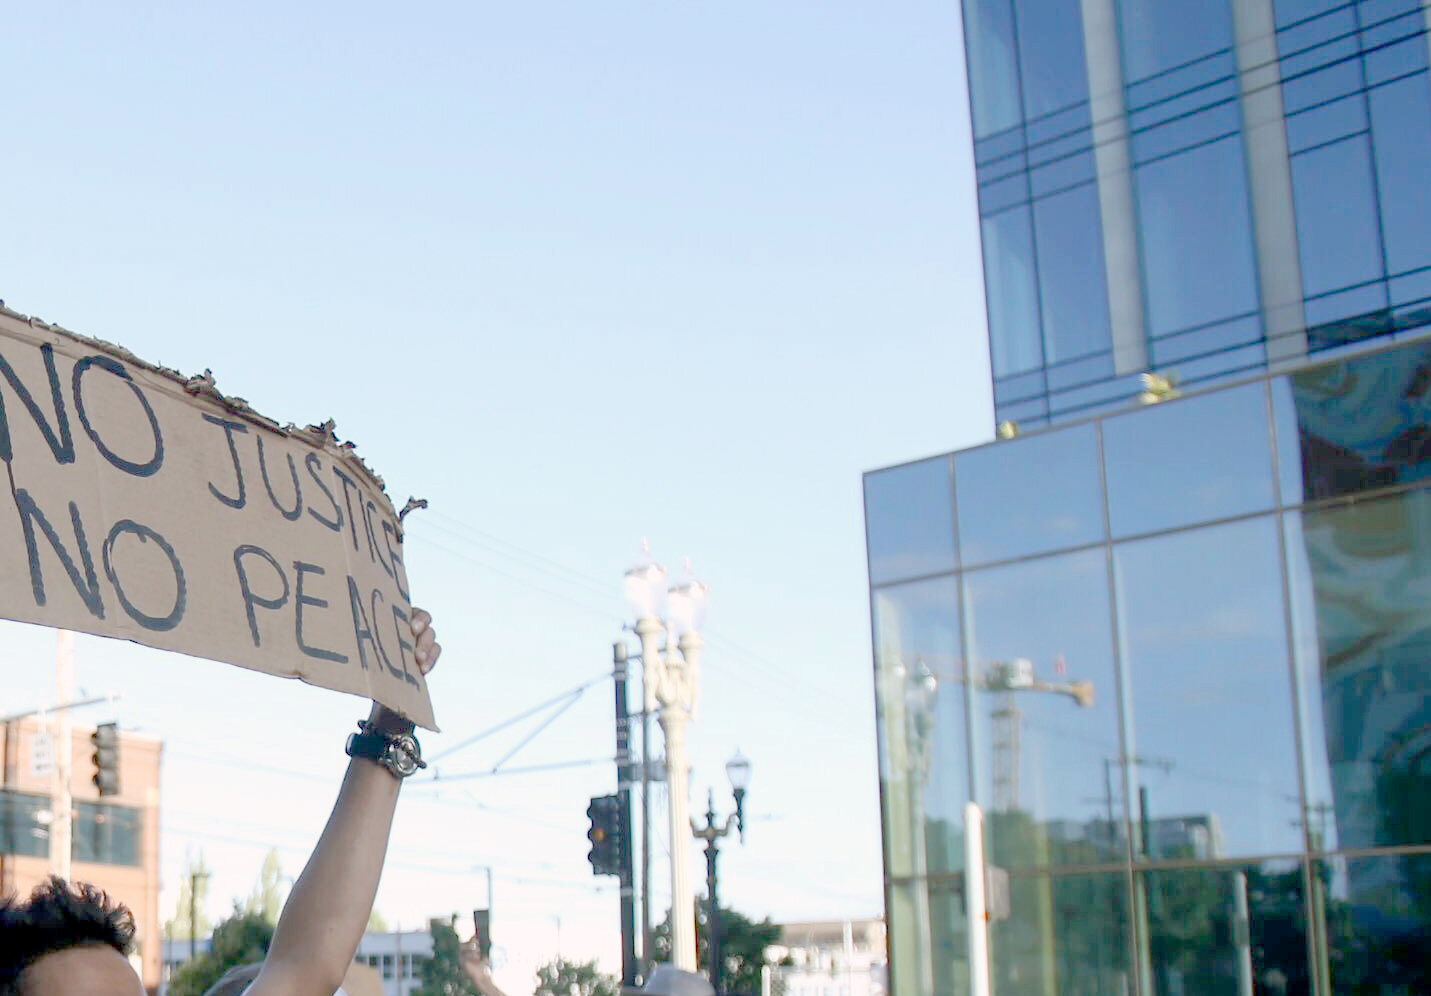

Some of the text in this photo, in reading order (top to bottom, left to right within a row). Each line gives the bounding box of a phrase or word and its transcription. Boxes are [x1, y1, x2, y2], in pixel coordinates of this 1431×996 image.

[14, 487, 420, 691] NO PEACE
[201, 412, 410, 604] JUSTICE
